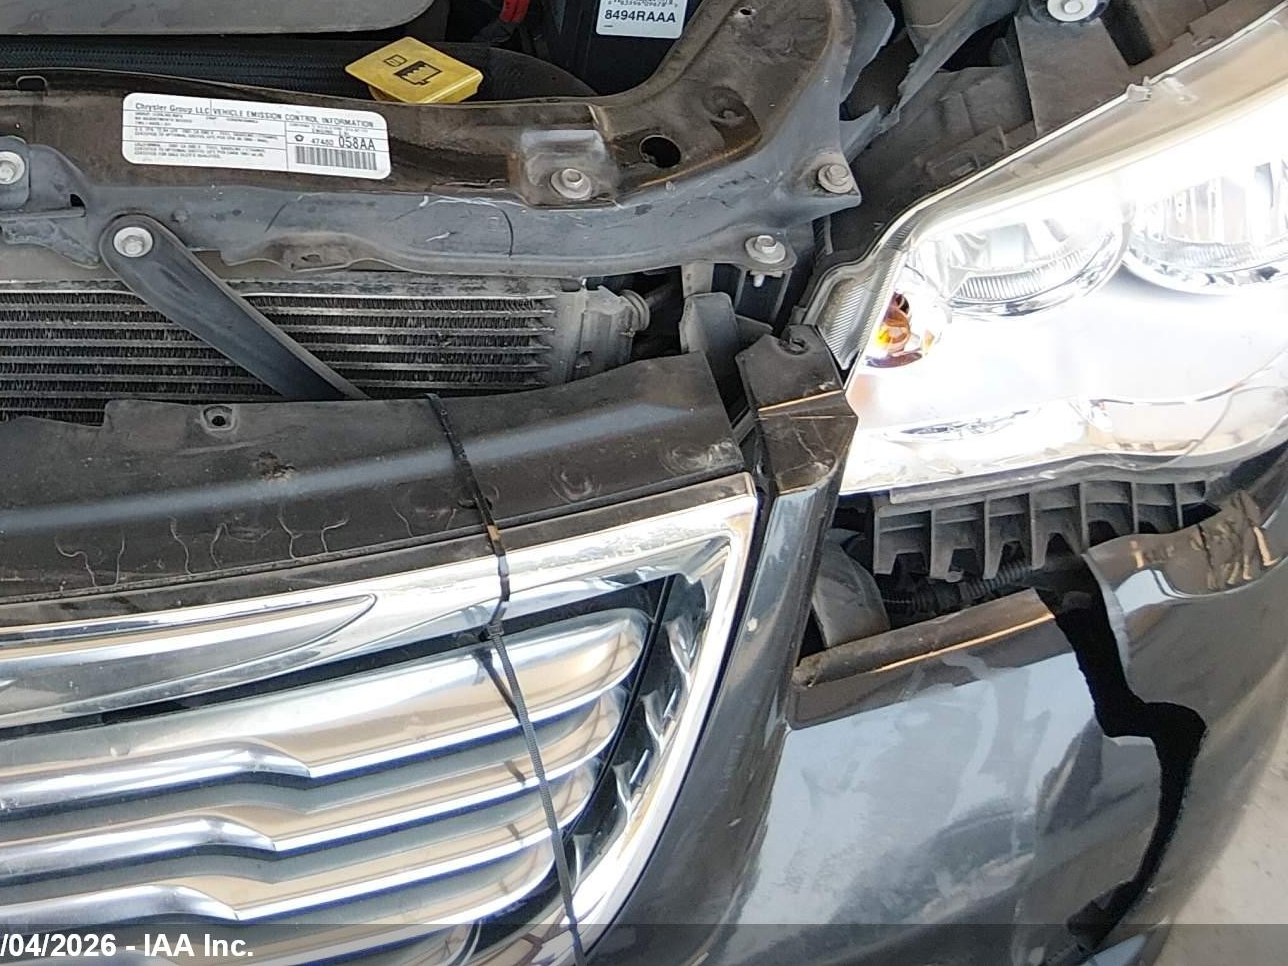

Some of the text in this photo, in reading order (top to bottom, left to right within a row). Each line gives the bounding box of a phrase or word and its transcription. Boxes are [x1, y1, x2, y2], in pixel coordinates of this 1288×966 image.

[604, 9, 676, 23] 8494RAAA
[135, 102, 167, 112] Chrysler
[169, 104, 193, 114] Group
[213, 109, 243, 117] VEHICLE
[246, 110, 282, 120] EMISSION
[284, 113, 318, 123] CONTROL
[322, 117, 374, 128] INFORMATION
[338, 135, 376, 151] 058AA
